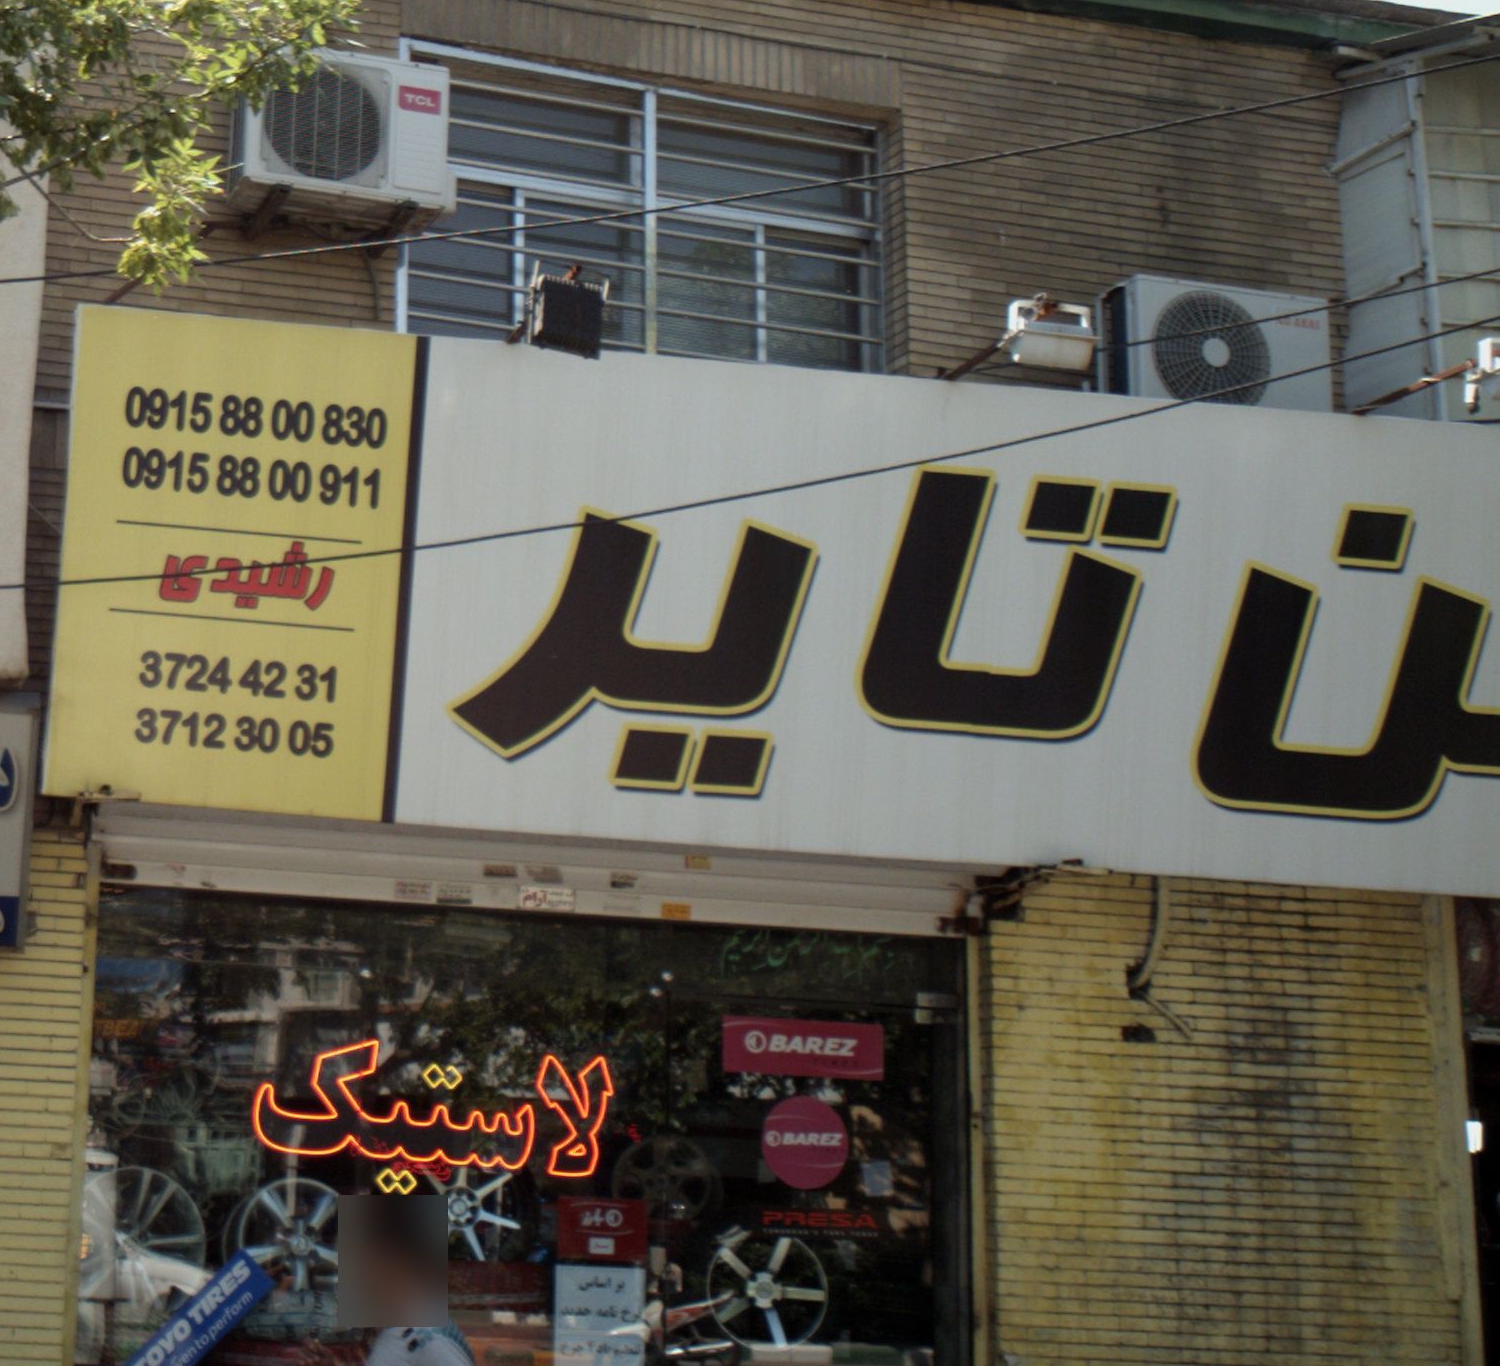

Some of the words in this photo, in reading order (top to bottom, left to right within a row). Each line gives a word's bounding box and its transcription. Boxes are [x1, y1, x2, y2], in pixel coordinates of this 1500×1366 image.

[404, 93, 436, 107] TCL
[125, 386, 213, 433] 0915
[219, 395, 263, 437] 88
[271, 400, 315, 442] 00
[322, 404, 388, 448] 830
[122, 446, 209, 493] 0915
[216, 455, 260, 497] 88
[269, 461, 312, 502] 00
[319, 465, 381, 509] 911
[159, 542, 334, 610] رشیدی
[455, 465, 1177, 797] تایر
[139, 651, 231, 693] 3724
[240, 660, 286, 697] 42
[294, 665, 338, 703] 31
[135, 709, 225, 749] 3712
[234, 717, 279, 754] 30
[289, 722, 334, 758] 05
[768, 1034, 858, 1056] BAREZ
[252, 1040, 614, 1195] لاستیک
[782, 1132, 843, 1146] BAREZ
[761, 1210, 879, 1229] PRESA
[188, 1259, 251, 1325] TIRES
[195, 1333, 209, 1349] to
[208, 1291, 253, 1341] perform
